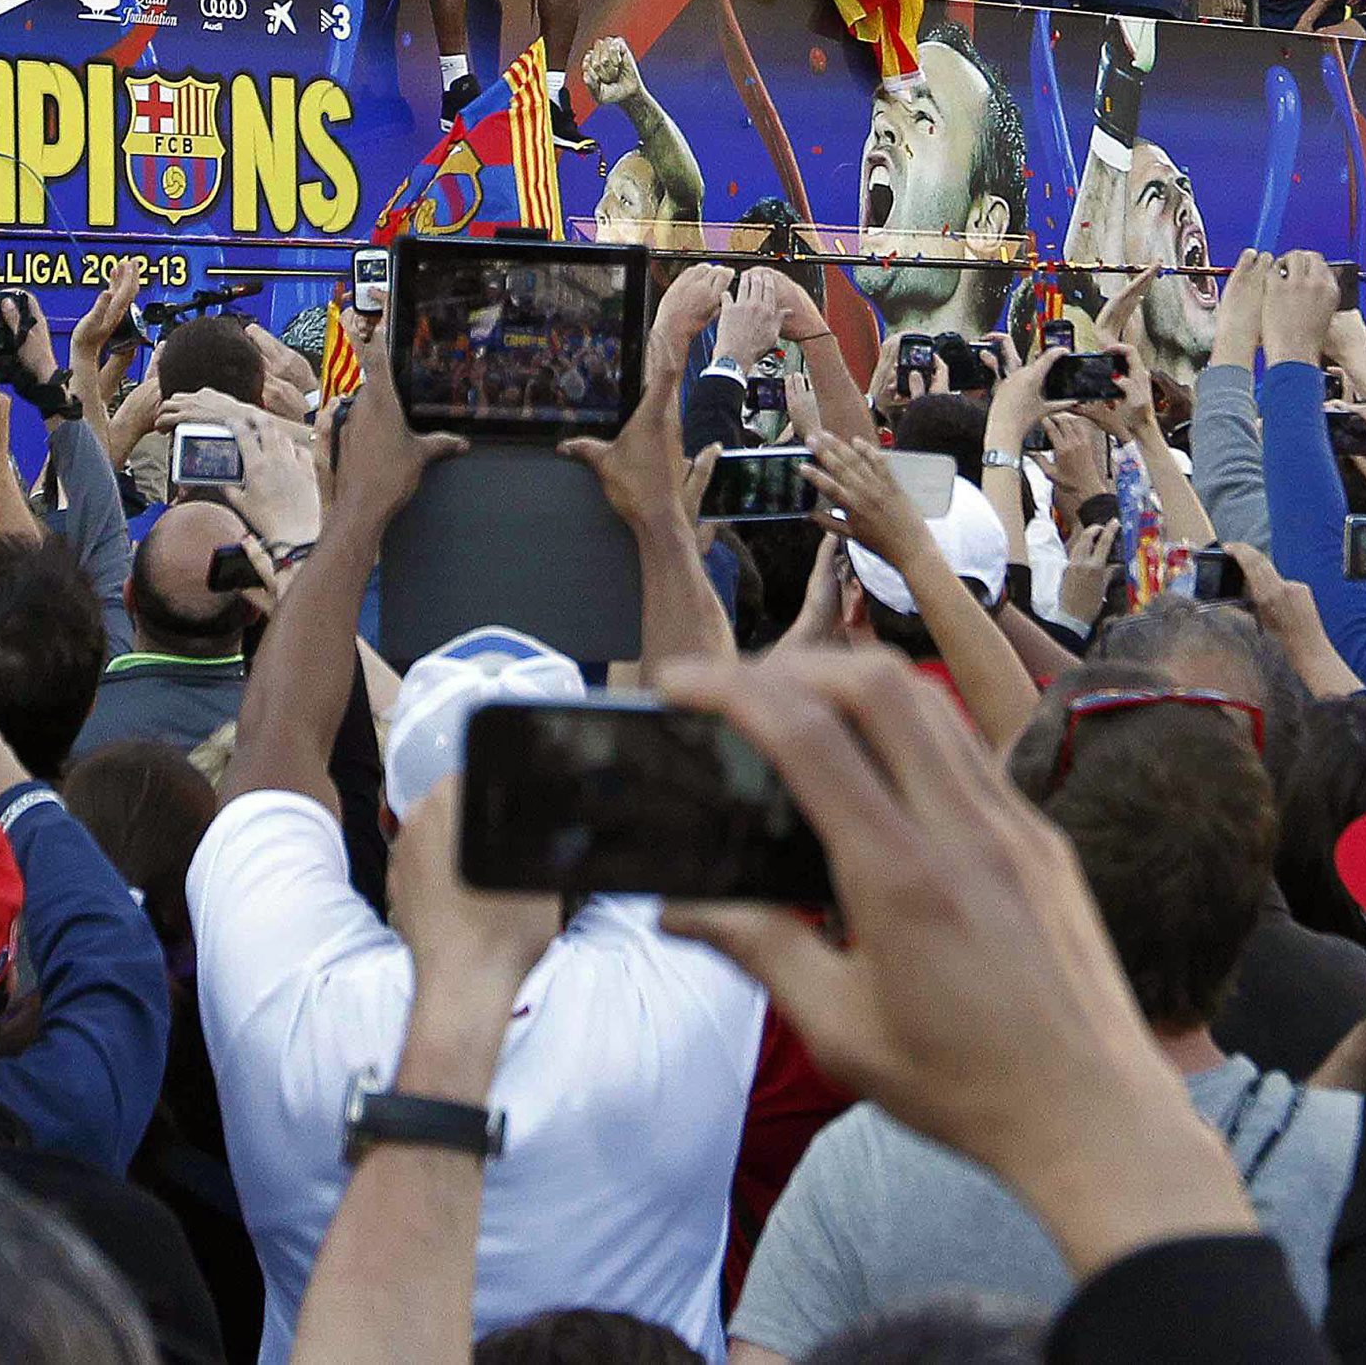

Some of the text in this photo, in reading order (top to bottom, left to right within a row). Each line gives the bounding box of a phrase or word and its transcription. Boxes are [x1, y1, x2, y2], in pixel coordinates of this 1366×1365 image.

[121, 7, 178, 27] Foundation
[202, 21, 223, 32] Audi
[155, 136, 193, 153] FCB
[81, 254, 187, 285] 202-13
